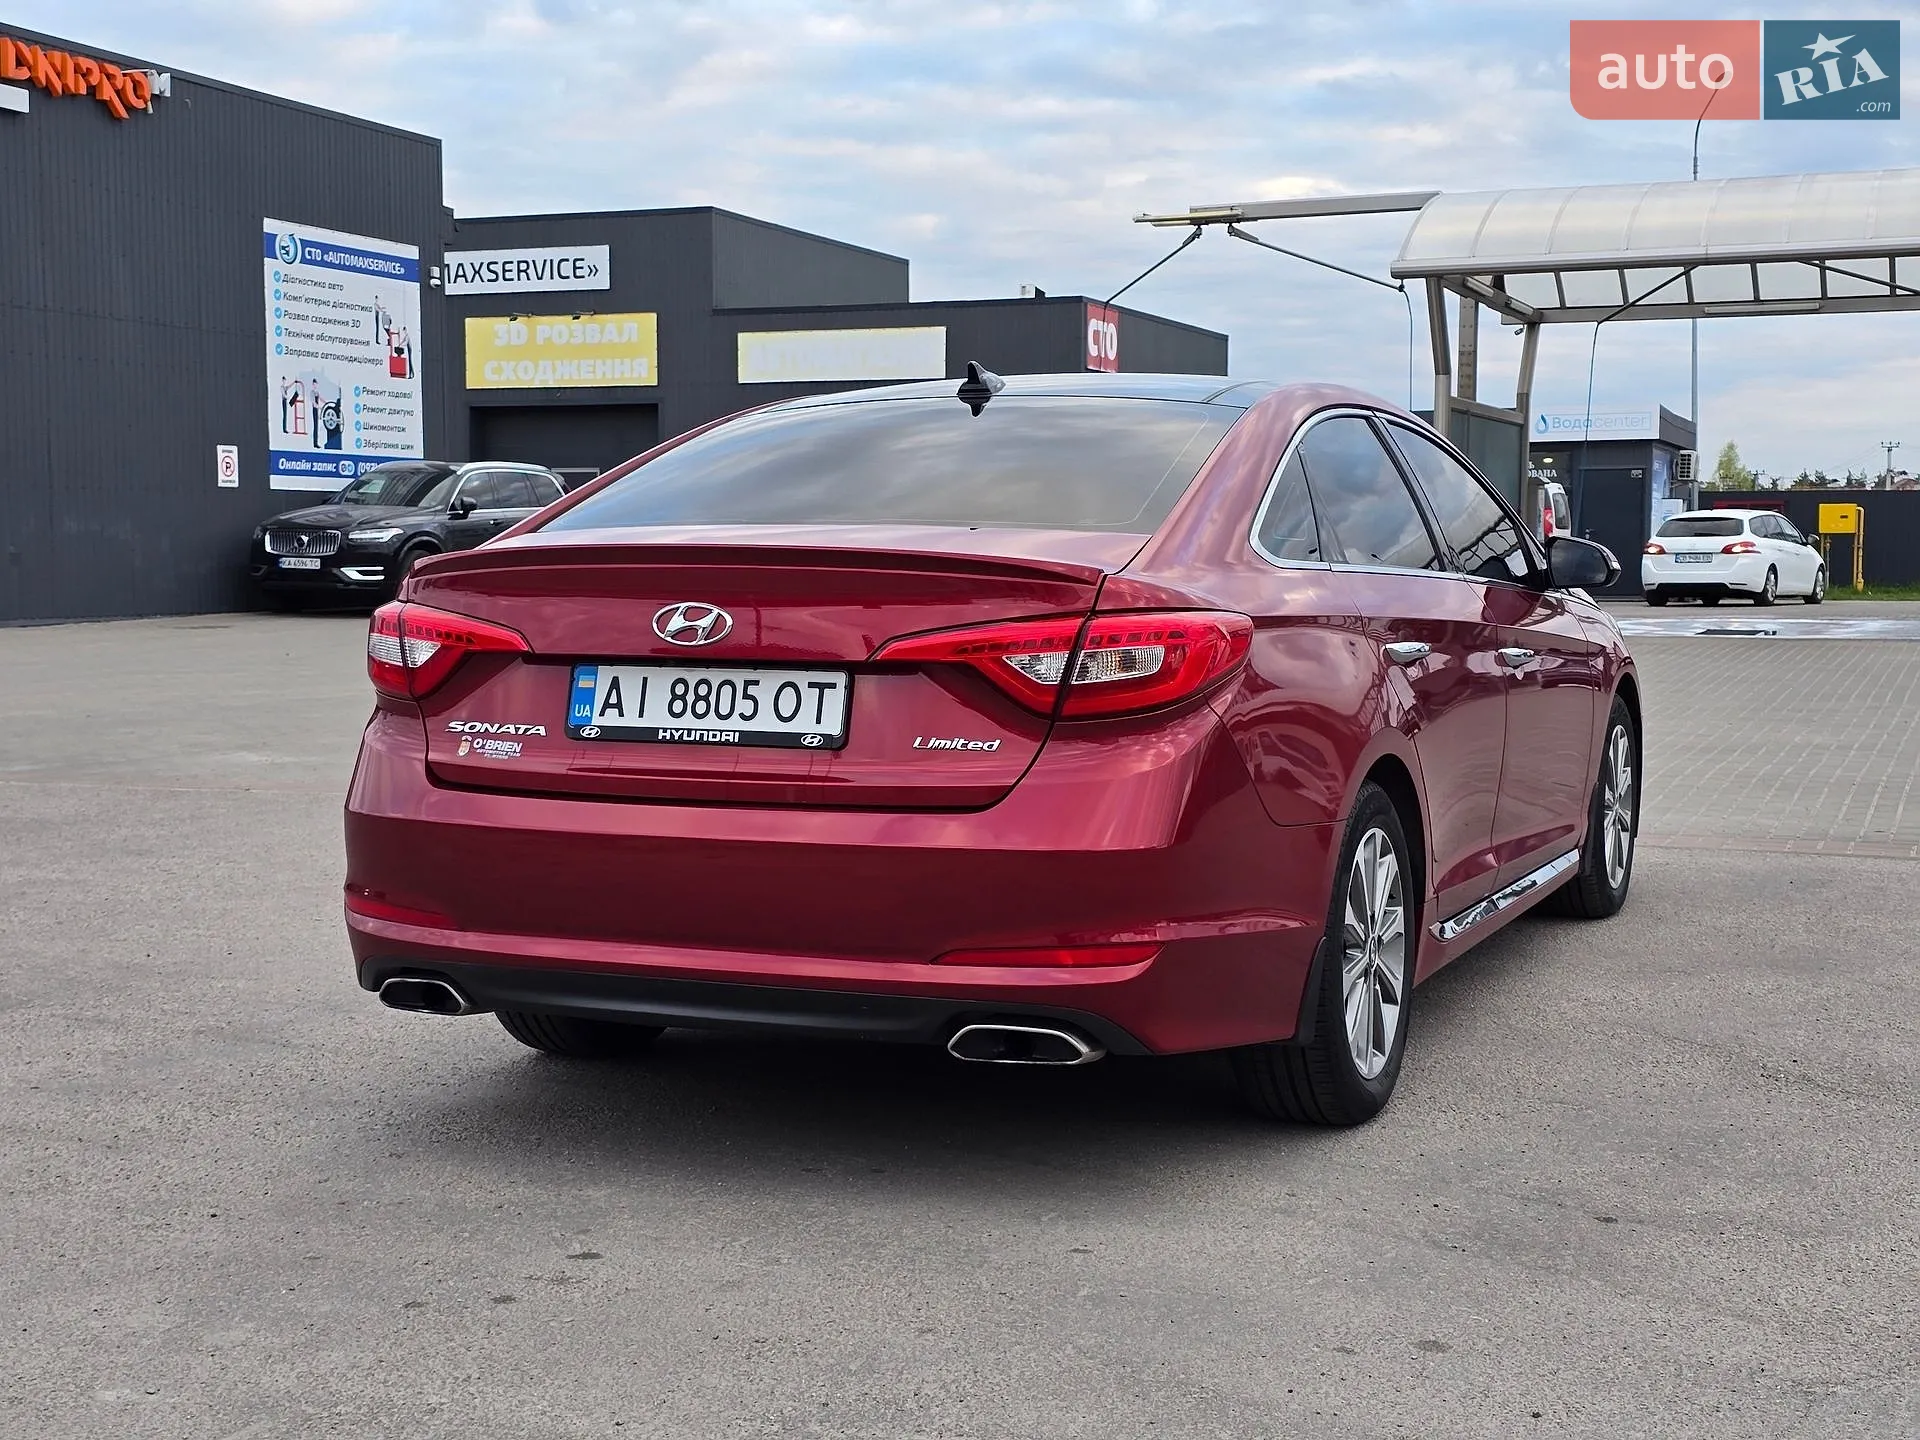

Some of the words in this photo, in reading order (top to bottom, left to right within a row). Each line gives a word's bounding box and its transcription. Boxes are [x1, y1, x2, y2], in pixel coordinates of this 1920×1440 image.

[305, 247, 322, 261] СТО
[323, 252, 405, 274] «AUTOMAXSERVICE»
[282, 273, 326, 289] Діагностика
[328, 283, 344, 291] авто
[332, 300, 373, 312] діагностика
[284, 310, 310, 321] Розвал
[351, 319, 361, 328] 3D
[284, 328, 314, 340] Технічне
[494, 324, 528, 346] 3D
[536, 322, 639, 345] РОЗВАЛ
[1088, 318, 1117, 361] СТО
[284, 346, 319, 358] Заправка
[483, 357, 649, 385] СХОДЖЕННЯ
[362, 386, 387, 396] Ремонт
[362, 404, 387, 413] Ремонт
[363, 422, 406, 432] Шиномонтаж
[278, 457, 312, 471] Онлайн
[312, 462, 337, 472] запис
[598, 676, 648, 719] AI
[668, 677, 761, 721] 8805
[773, 680, 837, 725] OT
[575, 703, 591, 717] UA
[445, 721, 547, 736] SONATA
[658, 728, 739, 742] HYUNDAI
[473, 738, 523, 753] O'BRIEN
[913, 736, 1001, 751] Limited
